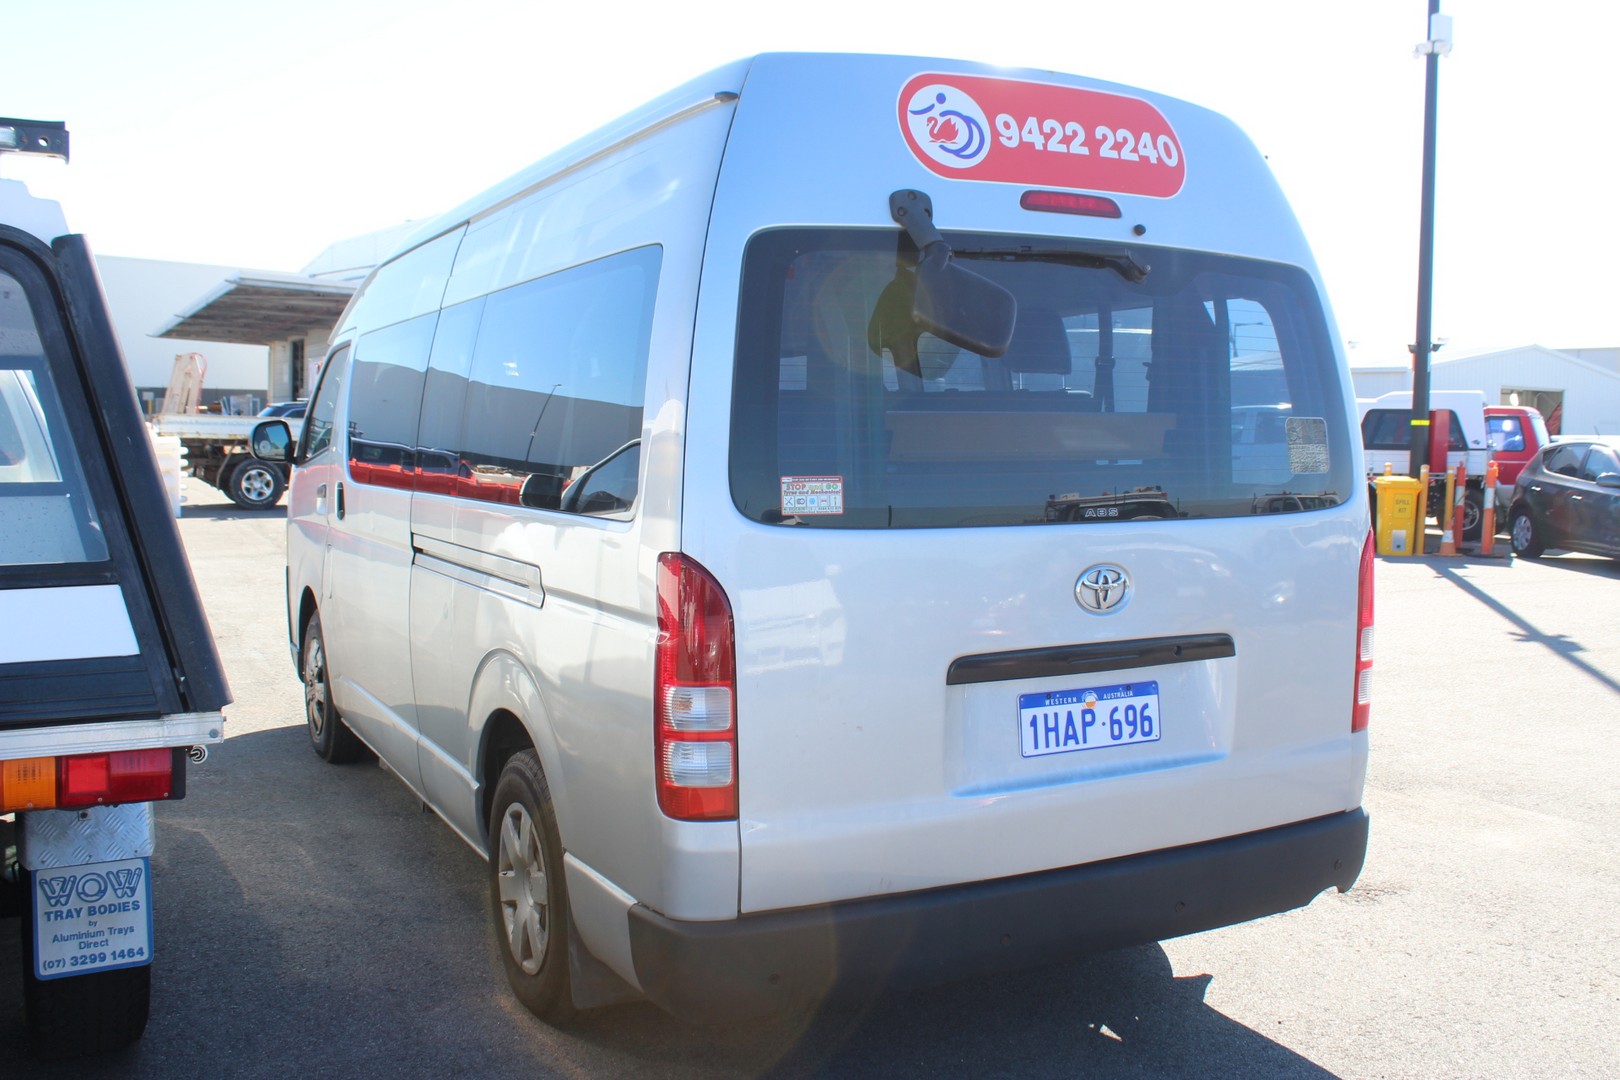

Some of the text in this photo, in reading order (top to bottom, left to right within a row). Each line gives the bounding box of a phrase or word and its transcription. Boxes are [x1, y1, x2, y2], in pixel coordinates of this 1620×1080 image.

[995, 113, 1178, 167] 9422 2240
[1085, 508, 1118, 517] ABS
[1045, 691, 1134, 706] WESTERN AUSTRALIA
[39, 867, 142, 907] WOW
[44, 900, 141, 922] TRAY BODIES
[52, 925, 135, 943] Aluminium Trays
[78, 939, 109, 950] Direct
[43, 947, 145, 971] (07) 3299 1464
